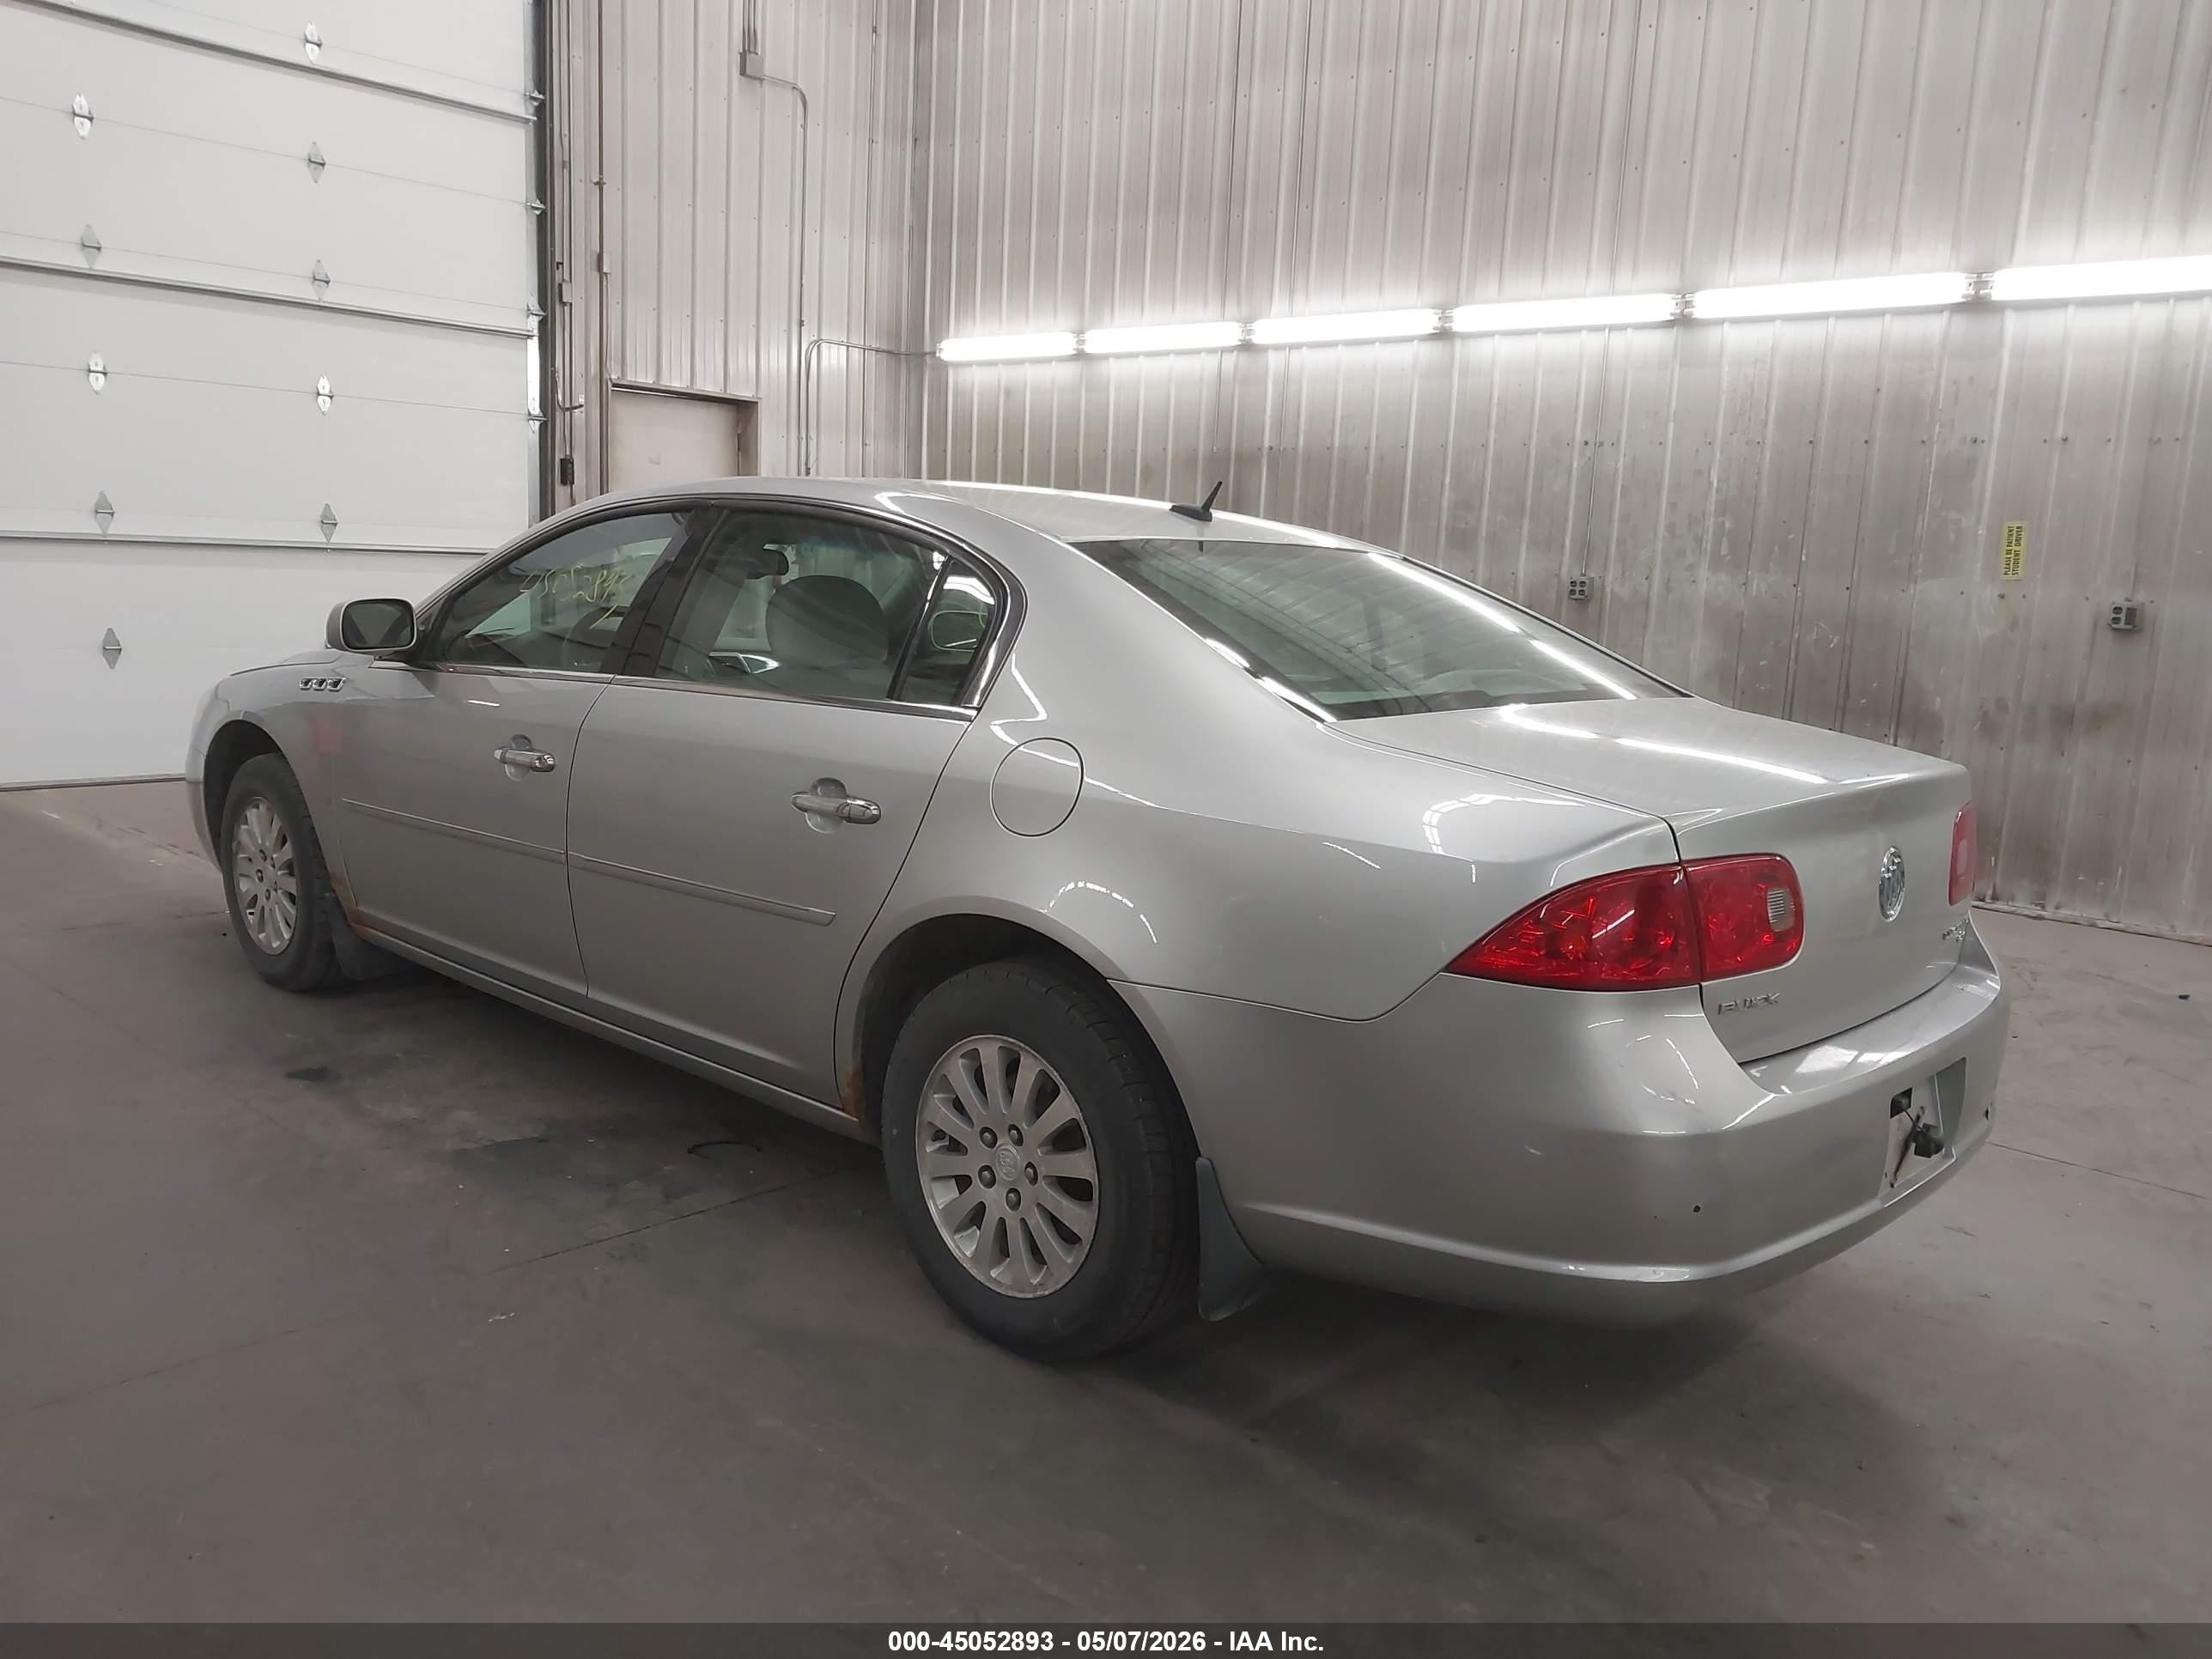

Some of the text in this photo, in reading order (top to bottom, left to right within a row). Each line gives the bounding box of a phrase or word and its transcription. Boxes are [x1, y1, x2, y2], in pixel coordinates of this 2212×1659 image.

[2006, 526, 2014, 548] PATIENT
[2012, 526, 2023, 576] STUDENT DRIVER
[2003, 556, 2012, 576] PLEASE
[1717, 992, 1781, 1015] BUICK
